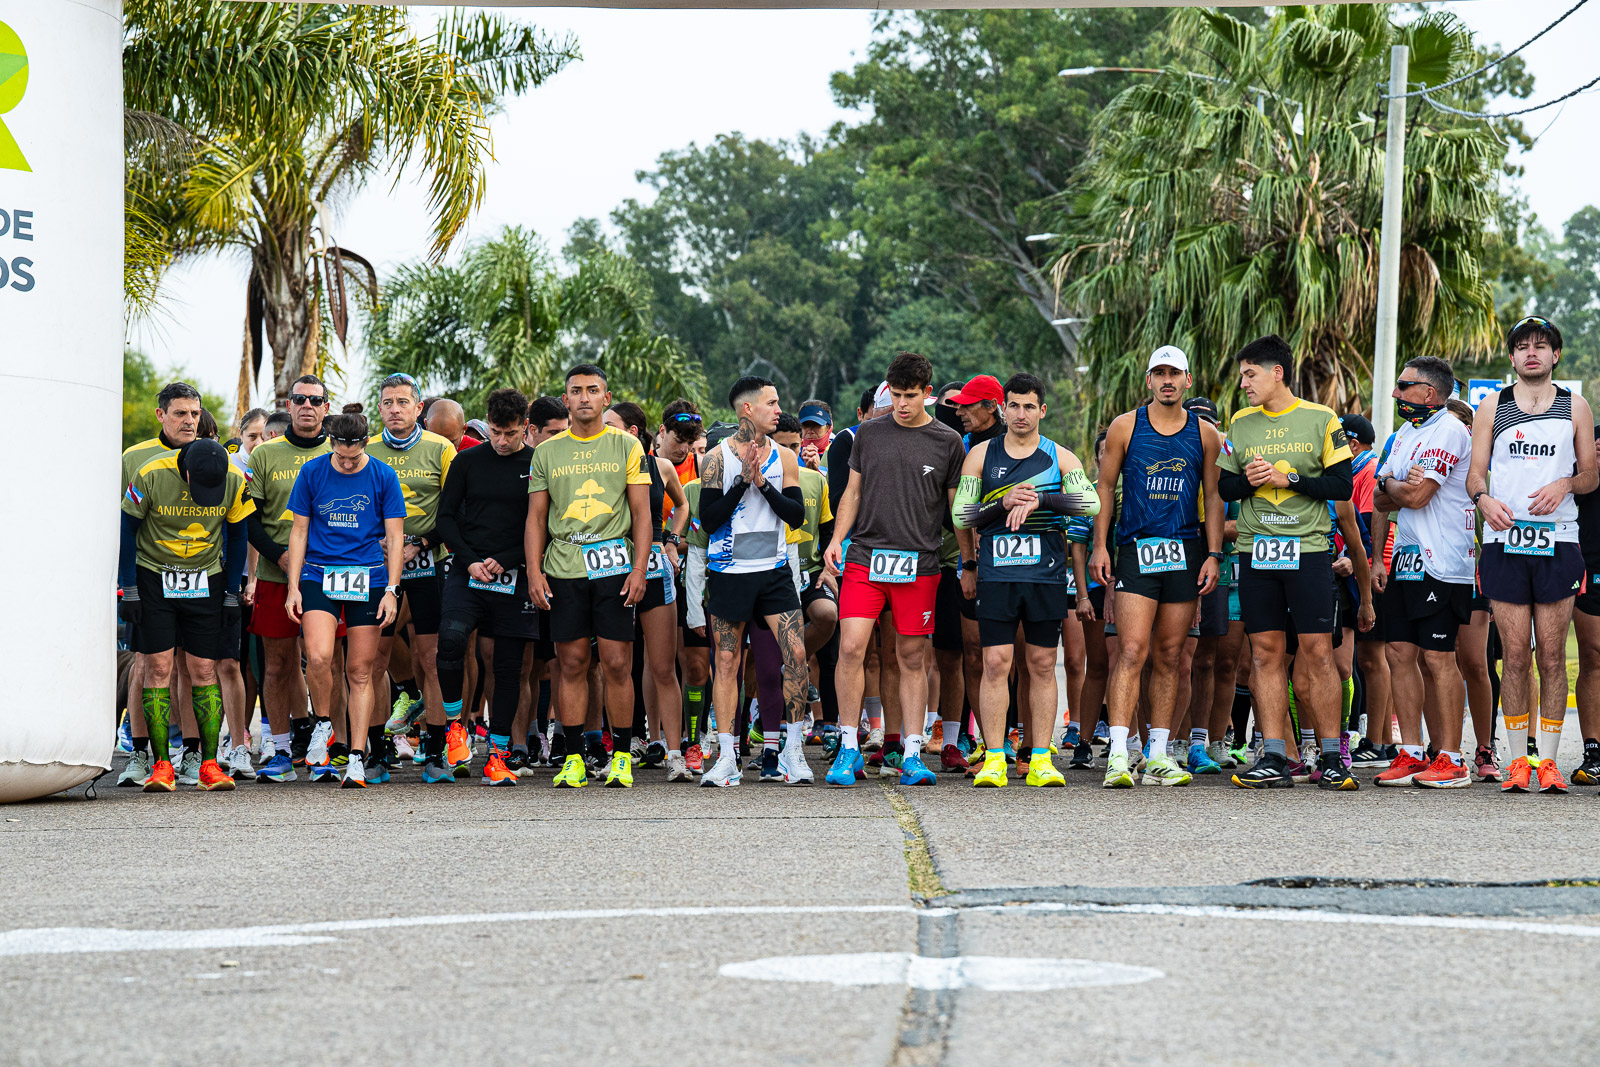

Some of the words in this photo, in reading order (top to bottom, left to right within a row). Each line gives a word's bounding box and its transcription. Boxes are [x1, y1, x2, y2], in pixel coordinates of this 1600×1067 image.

[1265, 427, 1289, 440] 216°
[573, 449, 597, 461] 216°
[1245, 442, 1314, 459] ANIVERSARIO
[386, 455, 410, 466] 216°
[395, 468, 432, 479] RSARIO
[552, 462, 620, 479] ANIVERSARIO
[991, 466, 1008, 479] SF
[1146, 476, 1185, 493] FARTLEK
[157, 505, 227, 517] ANIVERSARIO
[804, 498, 817, 507] RIO
[329, 512, 358, 522] FARTLEK
[1508, 525, 1550, 549] 095
[995, 535, 1034, 558] 021
[1140, 541, 1182, 567] 048
[1255, 538, 1296, 562] 034
[586, 544, 626, 572] 035
[648, 550, 658, 572] 3
[873, 553, 914, 577] 074
[1397, 550, 1424, 573] 046
[590, 570, 615, 579] DIAMANTE
[1142, 565, 1167, 573] DIAMANTE
[165, 570, 203, 592] 037
[327, 570, 366, 594] 114
[470, 582, 496, 591] DIAMANTE
